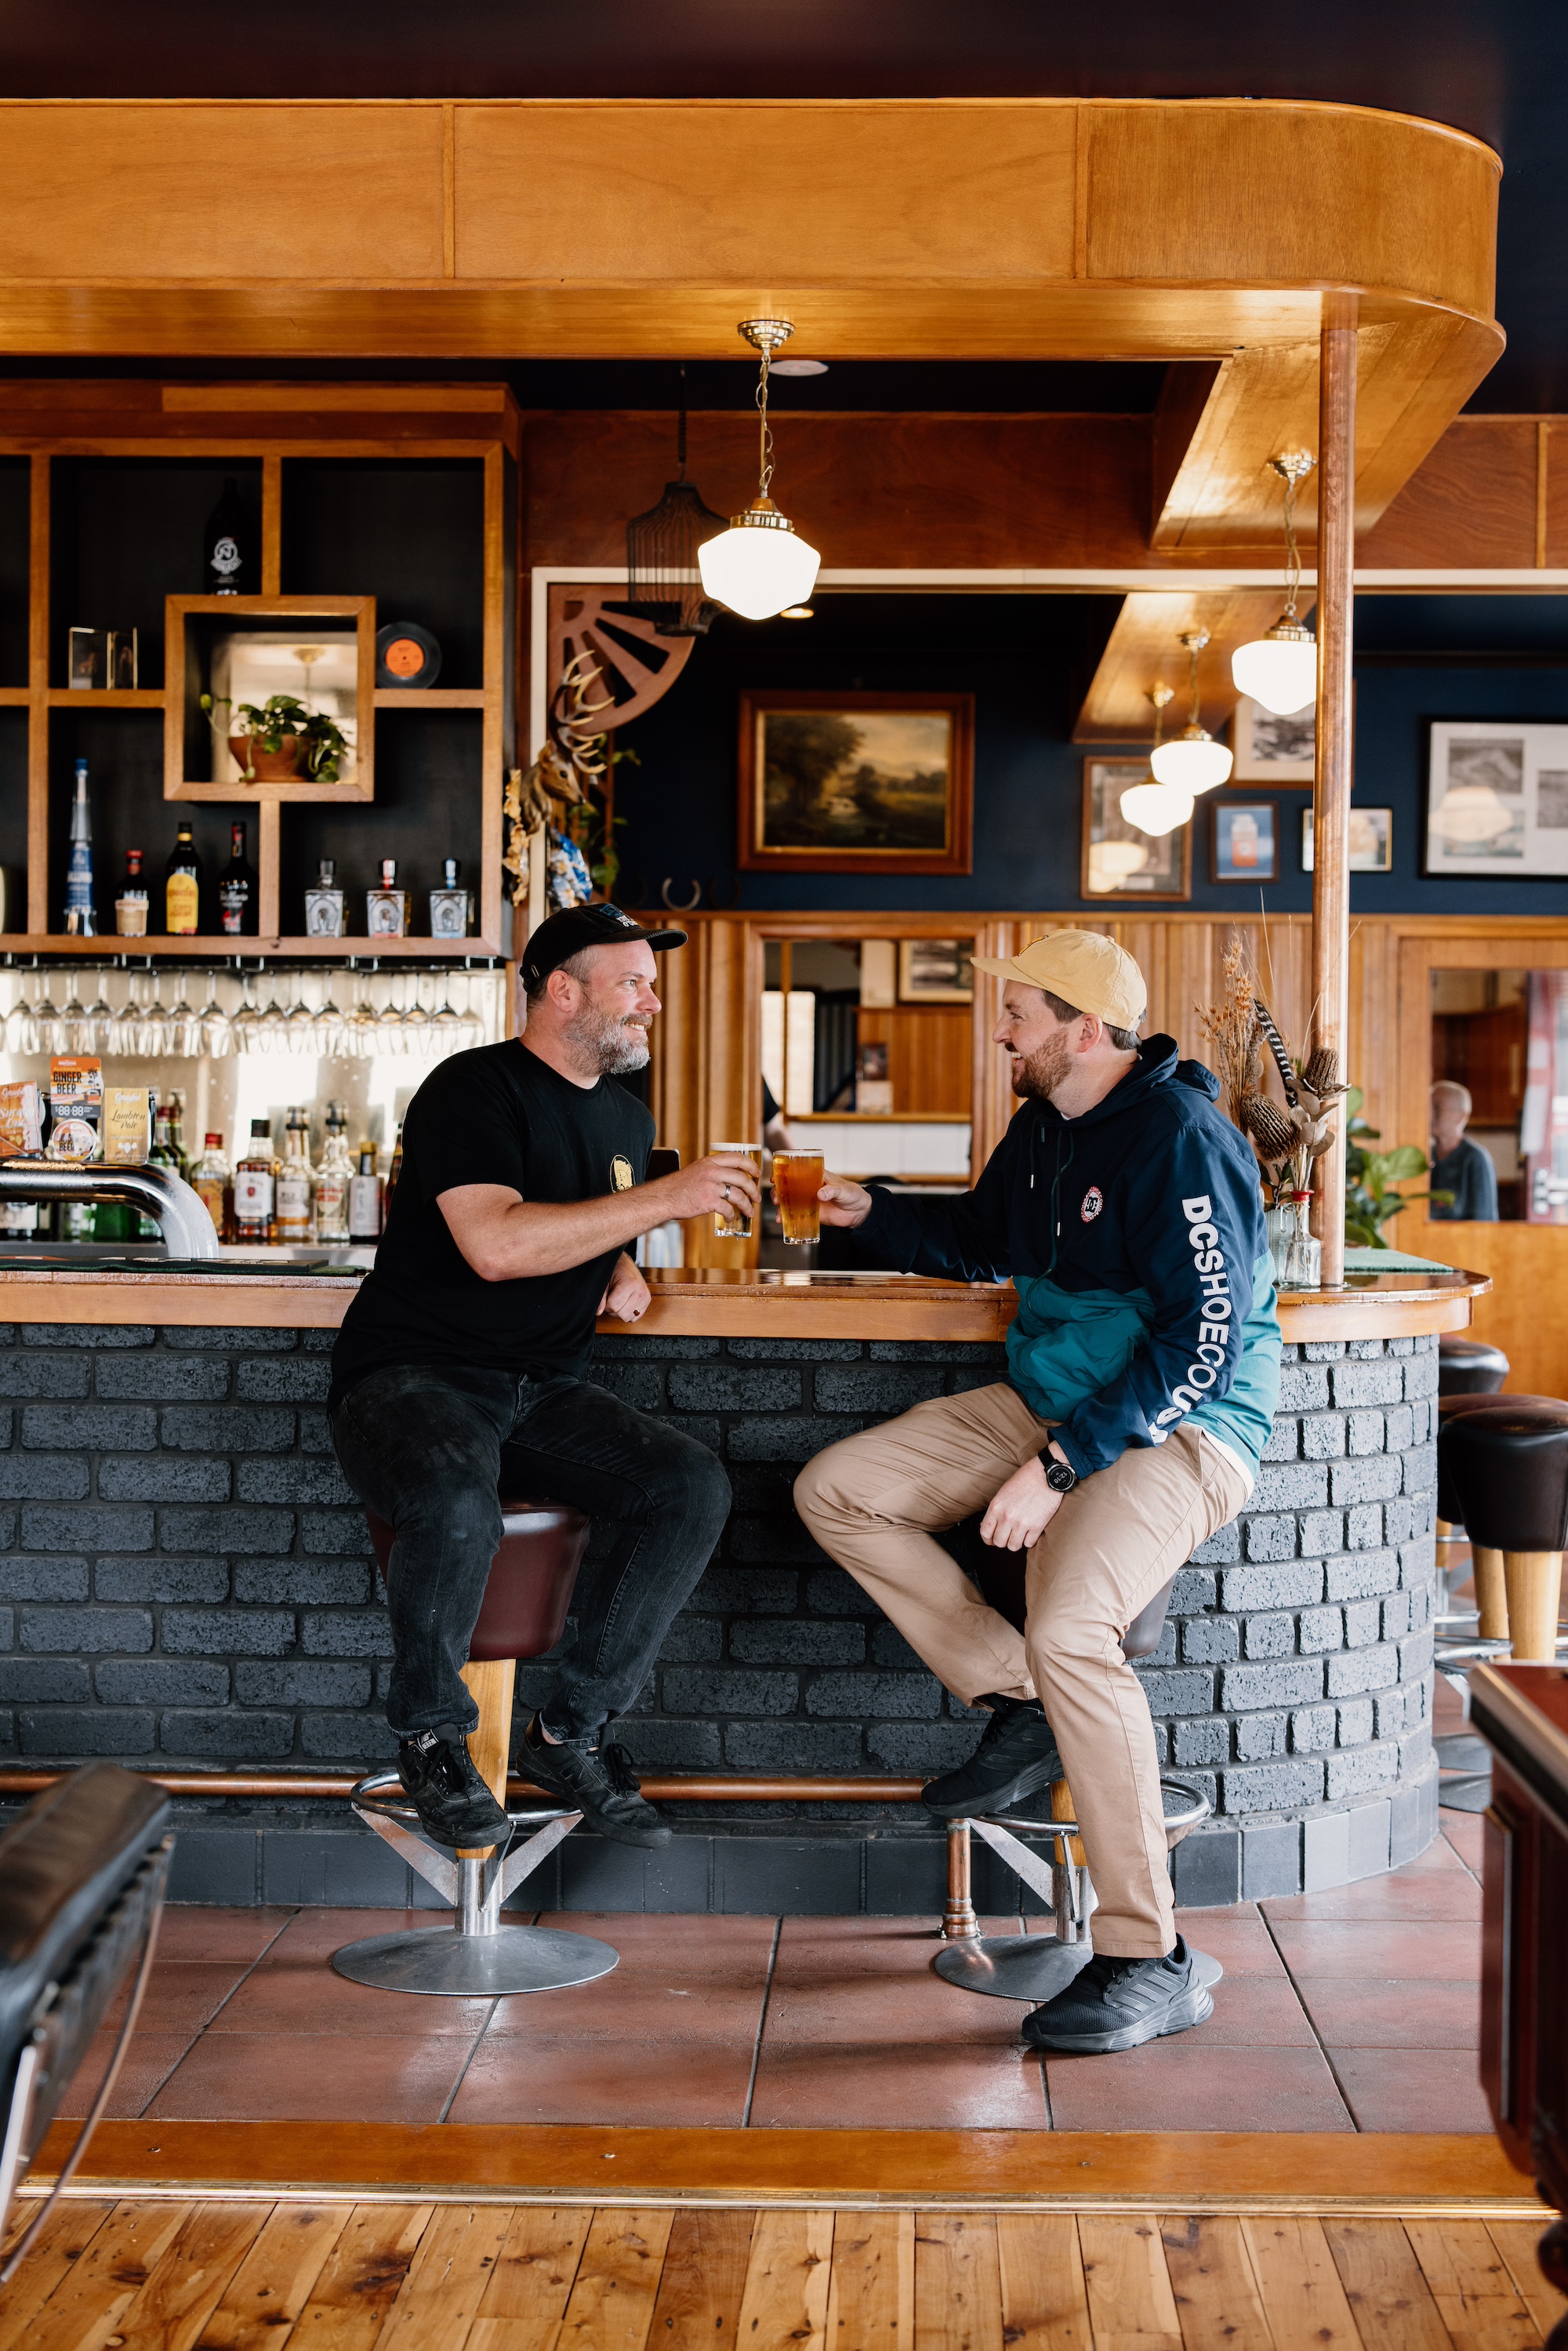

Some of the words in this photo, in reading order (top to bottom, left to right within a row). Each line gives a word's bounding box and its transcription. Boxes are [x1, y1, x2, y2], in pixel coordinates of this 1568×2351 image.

[53, 1071, 82, 1083] GINGER
[56, 1083, 76, 1094] BEER
[109, 1109, 146, 1123] Lambton
[1054, 1471, 1067, 1484] 12:10
